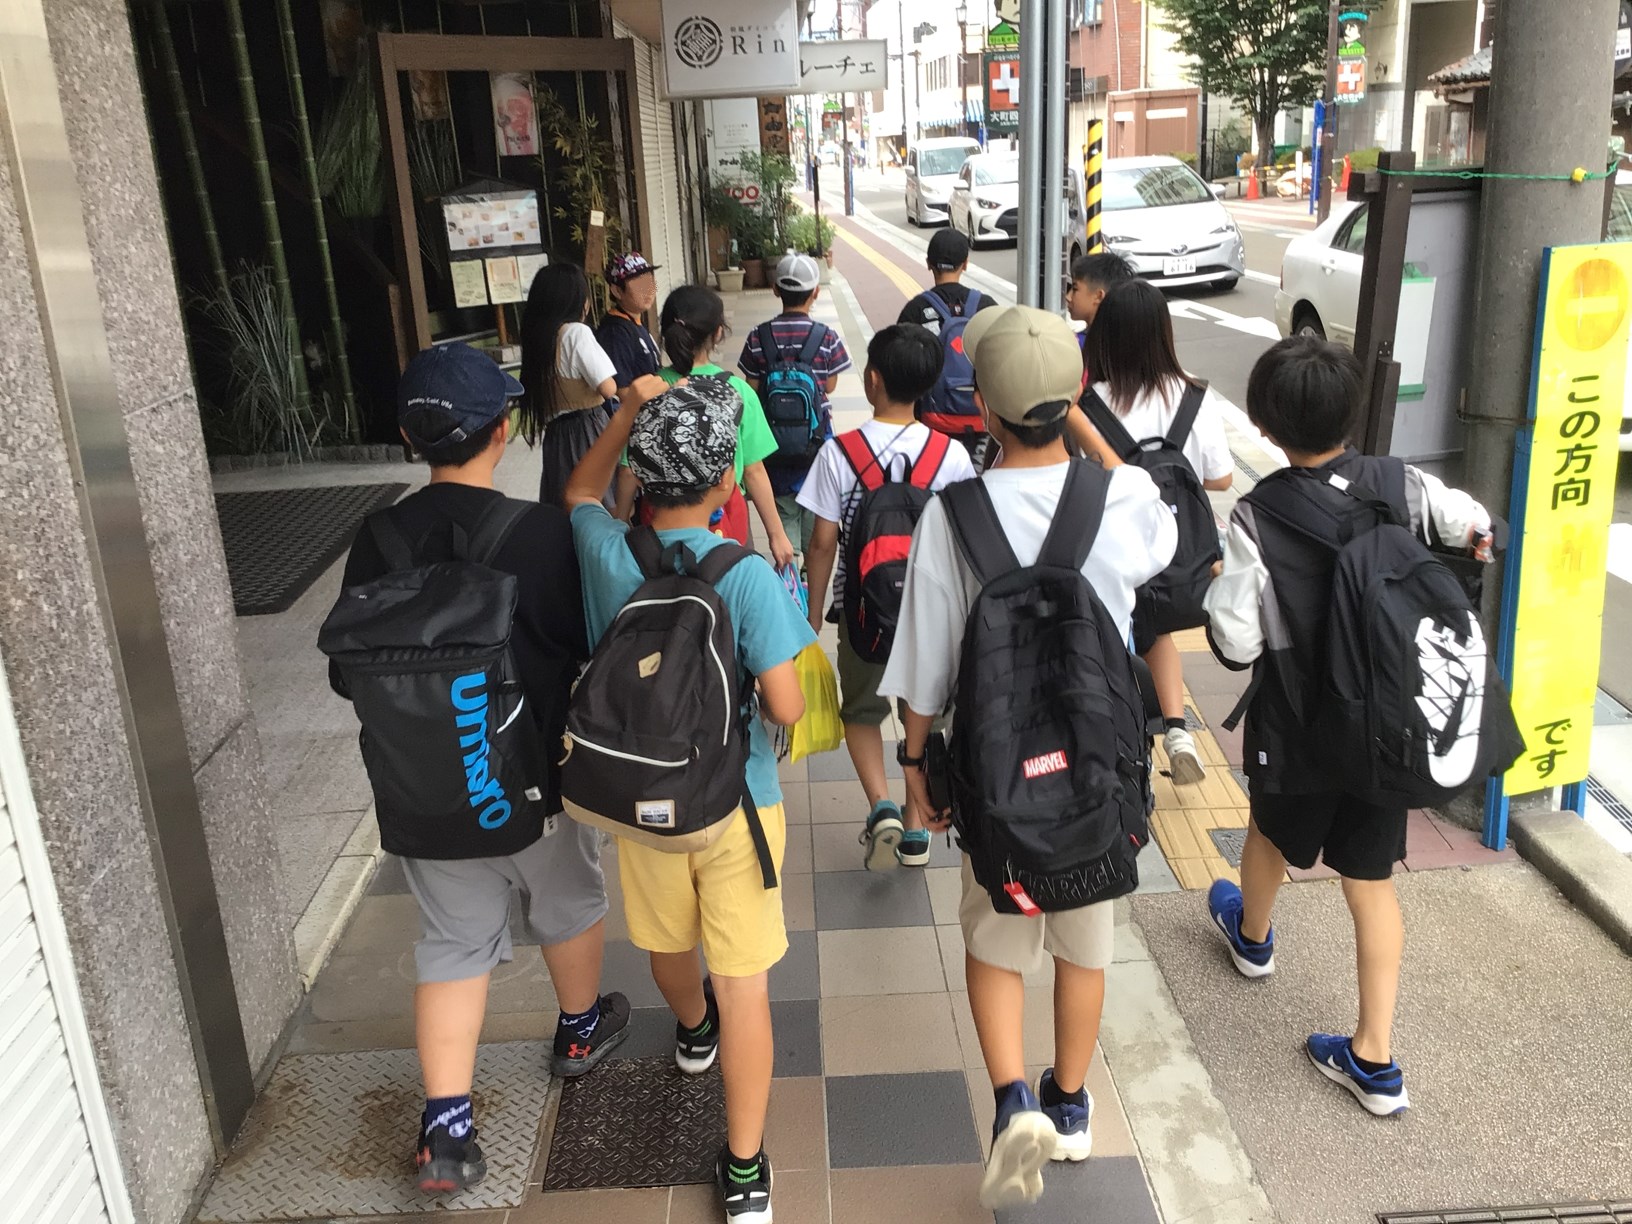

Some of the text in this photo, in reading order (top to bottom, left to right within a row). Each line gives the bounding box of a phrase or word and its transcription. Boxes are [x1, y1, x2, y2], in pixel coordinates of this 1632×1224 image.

[731, 34, 785, 55] Rin
[1552, 375, 1600, 511] この方向
[1023, 750, 1066, 777] MARVEL
[1530, 718, 1572, 779] です
